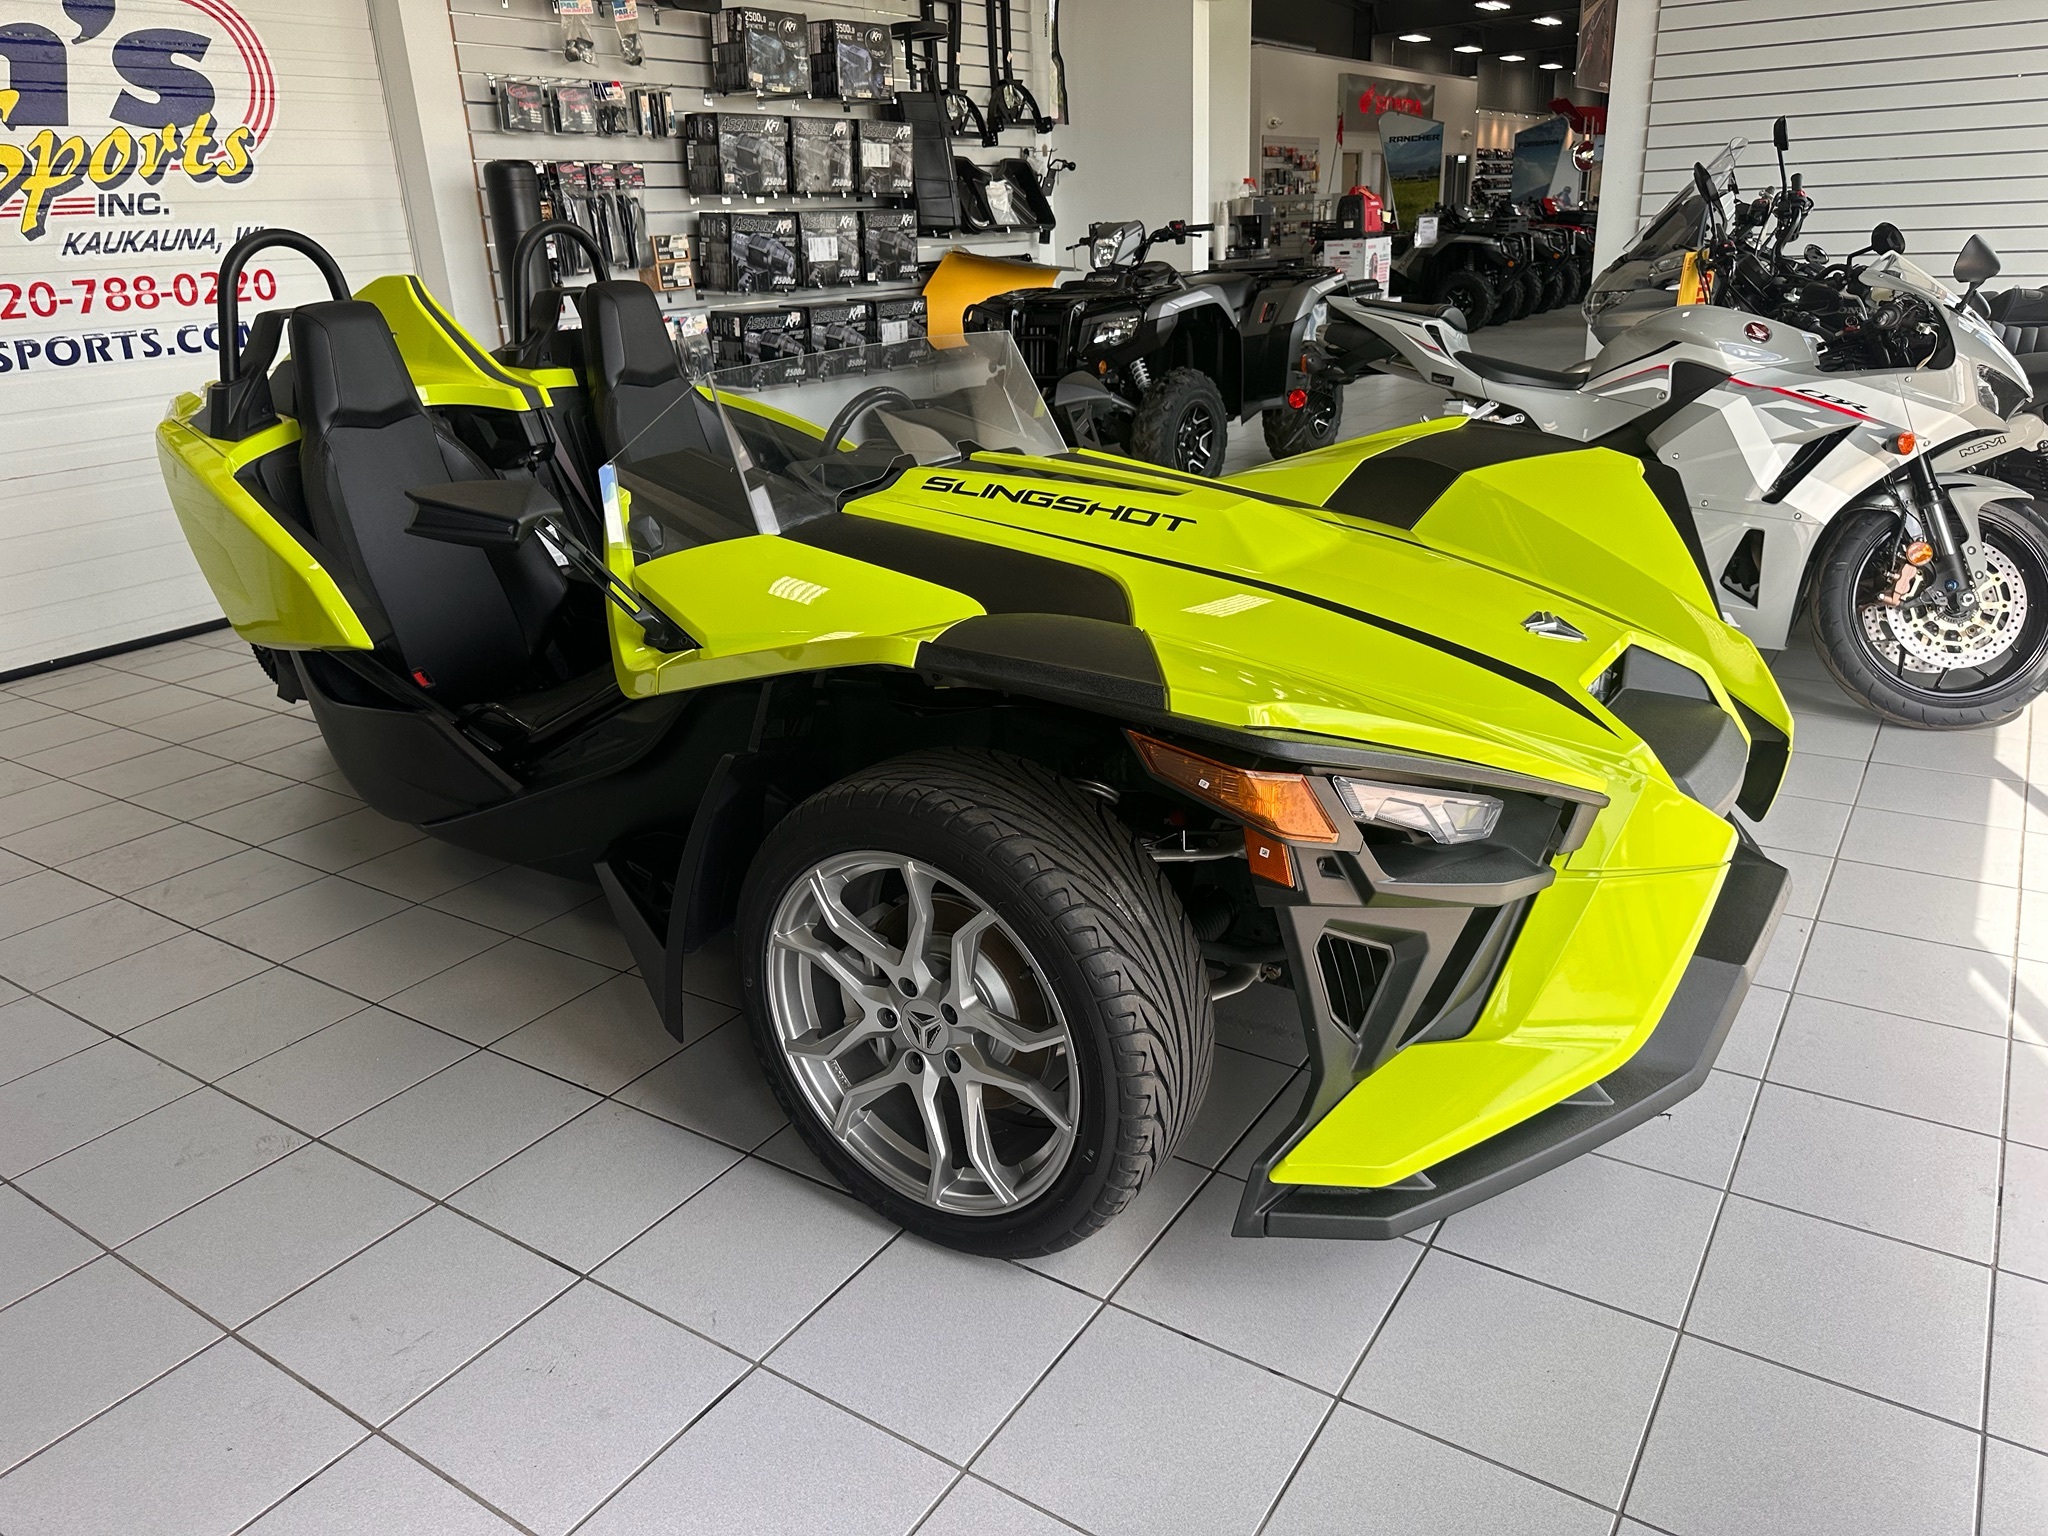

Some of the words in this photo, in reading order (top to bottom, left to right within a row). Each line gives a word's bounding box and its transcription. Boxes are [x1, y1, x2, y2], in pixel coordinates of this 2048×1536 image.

[720, 116, 765, 132] ASSAULT
[1389, 133, 1440, 144] RANCHER
[98, 192, 170, 217] INC.
[733, 216, 778, 232] ASSAULT
[62, 227, 222, 256] KAUKAUNA,
[236, 226, 265, 244] W
[745, 316, 787, 332] ASSAULT
[1959, 435, 2007, 458] NAVI
[921, 475, 1198, 533] SLINGSHOT
